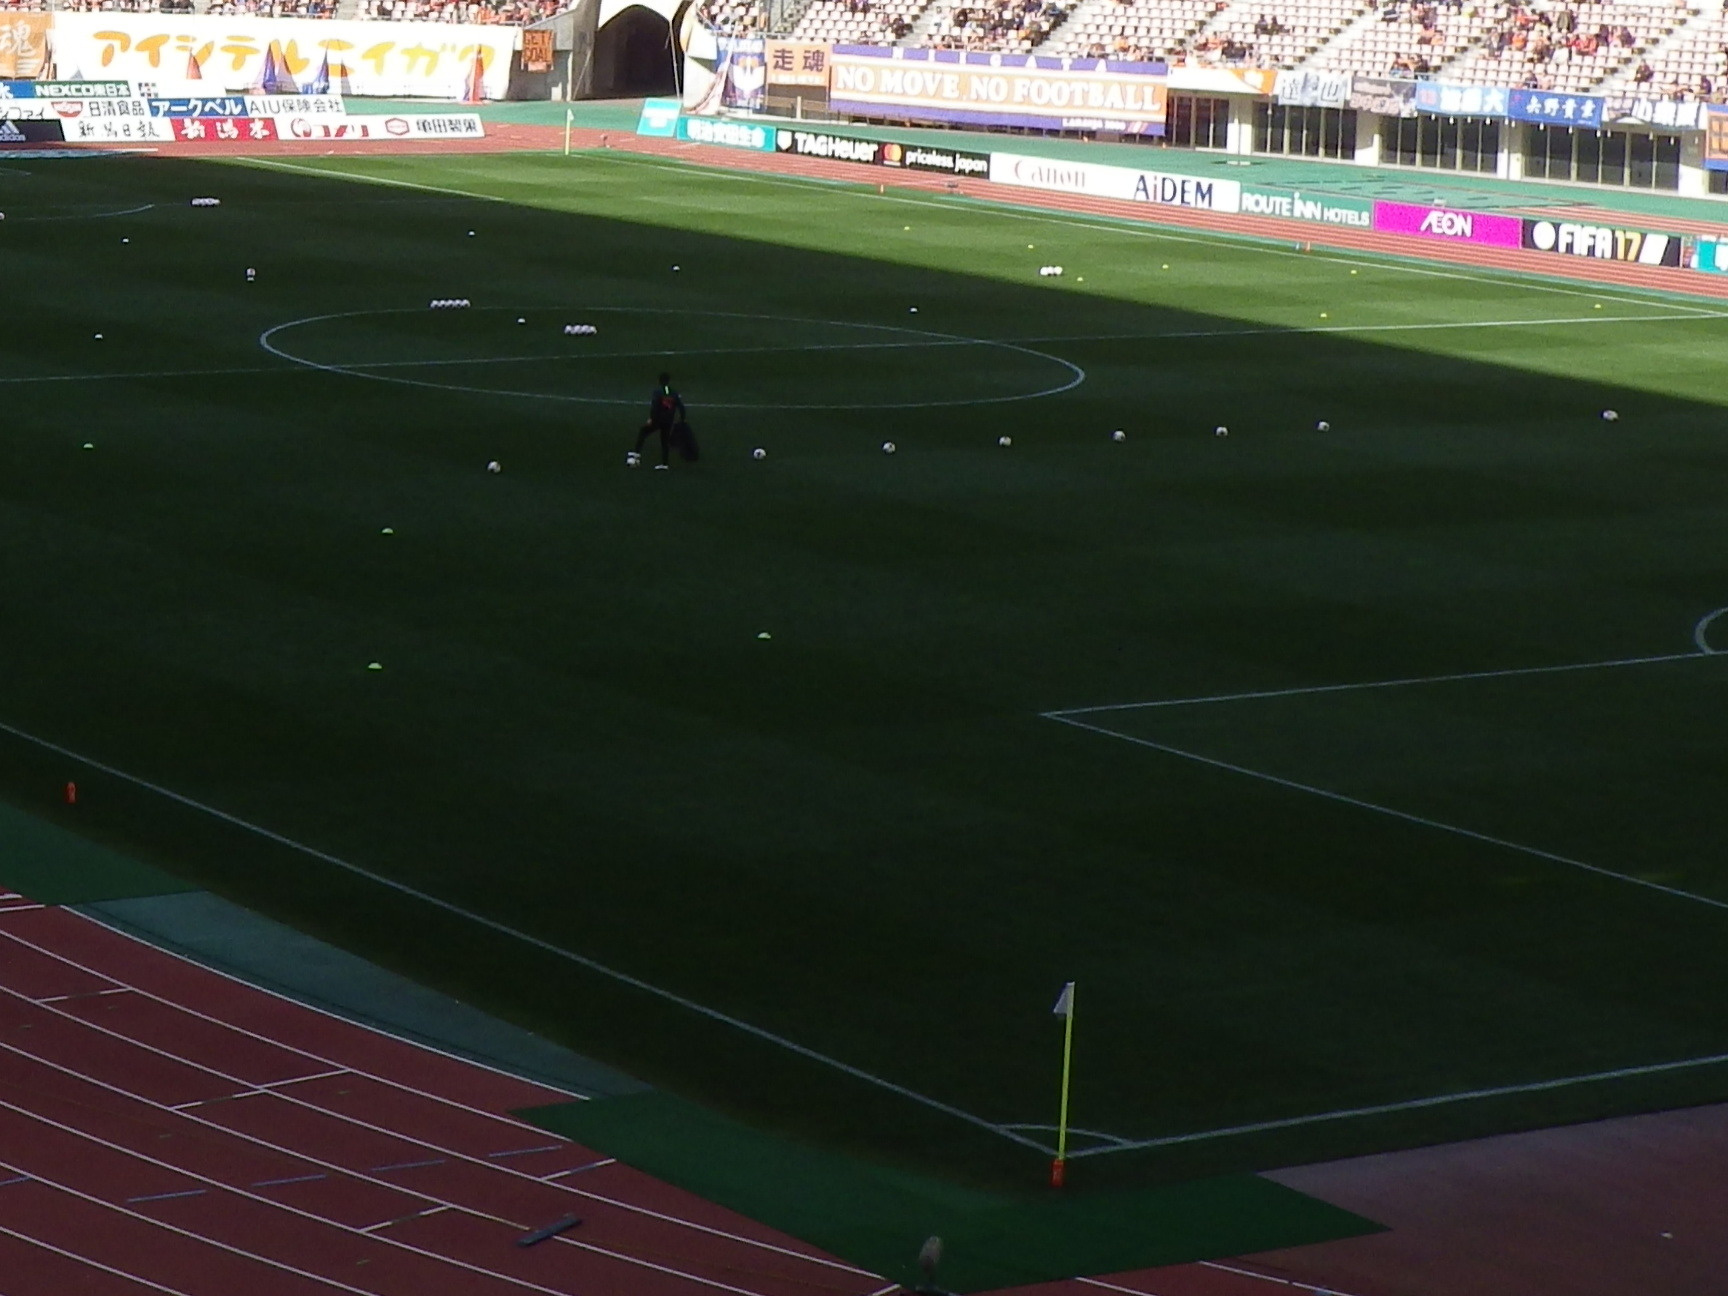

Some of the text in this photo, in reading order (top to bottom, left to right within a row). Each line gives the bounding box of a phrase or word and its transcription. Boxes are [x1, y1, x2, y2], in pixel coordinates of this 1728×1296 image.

[773, 48, 825, 73] 走魂
[36, 83, 130, 98] NEXCO東日本
[836, 65, 875, 93] NO
[970, 75, 1009, 101] NO
[1013, 80, 1161, 112] FOOTBALL
[88, 100, 145, 117] 日清食品
[151, 97, 242, 117] アークベル
[250, 99, 343, 116] AIU保険会社
[795, 132, 829, 156] TAG
[905, 149, 987, 173] priceless japan
[1241, 193, 1291, 218] ROUTE
[1559, 223, 1612, 260] FIFA
[1614, 229, 1641, 262] 17
